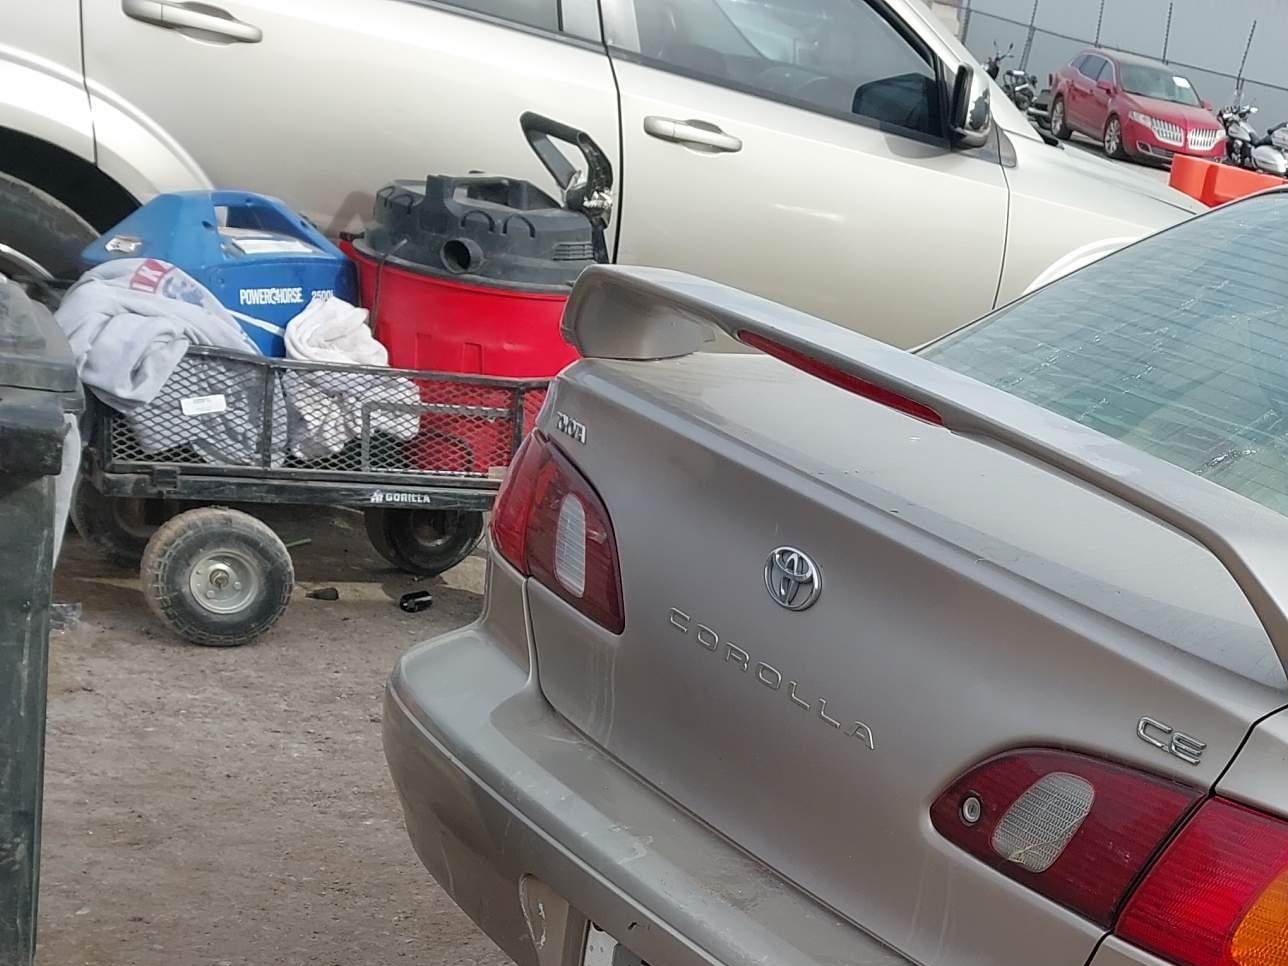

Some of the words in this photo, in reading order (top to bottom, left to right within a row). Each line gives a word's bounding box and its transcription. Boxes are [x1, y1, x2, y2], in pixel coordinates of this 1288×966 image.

[385, 492, 432, 504] GORILLA
[668, 606, 876, 751] COROLLA
[1136, 715, 1208, 767] CE
